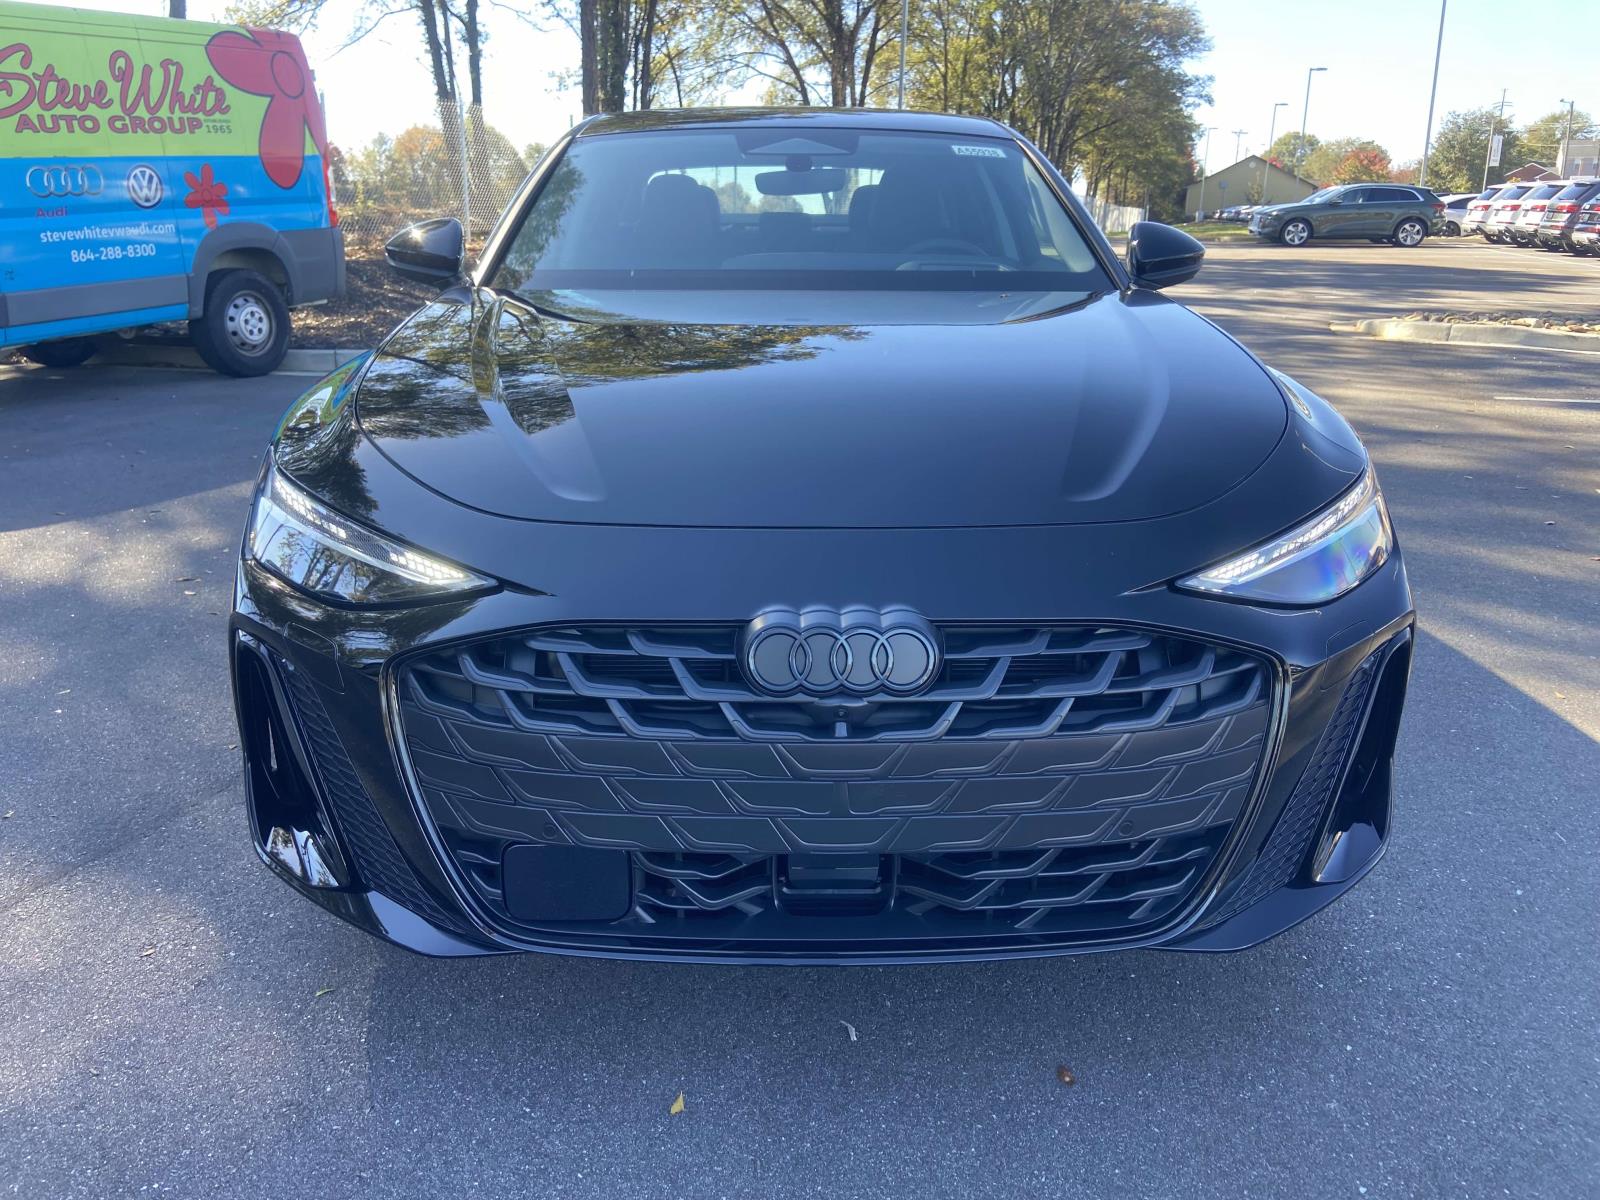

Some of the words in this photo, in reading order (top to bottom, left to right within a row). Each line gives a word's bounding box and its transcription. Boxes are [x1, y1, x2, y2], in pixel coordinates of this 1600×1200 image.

[0, 43, 114, 119] Steve
[109, 50, 231, 116] White
[15, 114, 101, 134] AUTO
[107, 115, 204, 134] GROUP
[205, 124, 233, 134] 1965
[36, 206, 68, 218] Audi
[40, 222, 176, 243] stevewhitevwaudi.com
[70, 243, 157, 263] 864-288-8300
